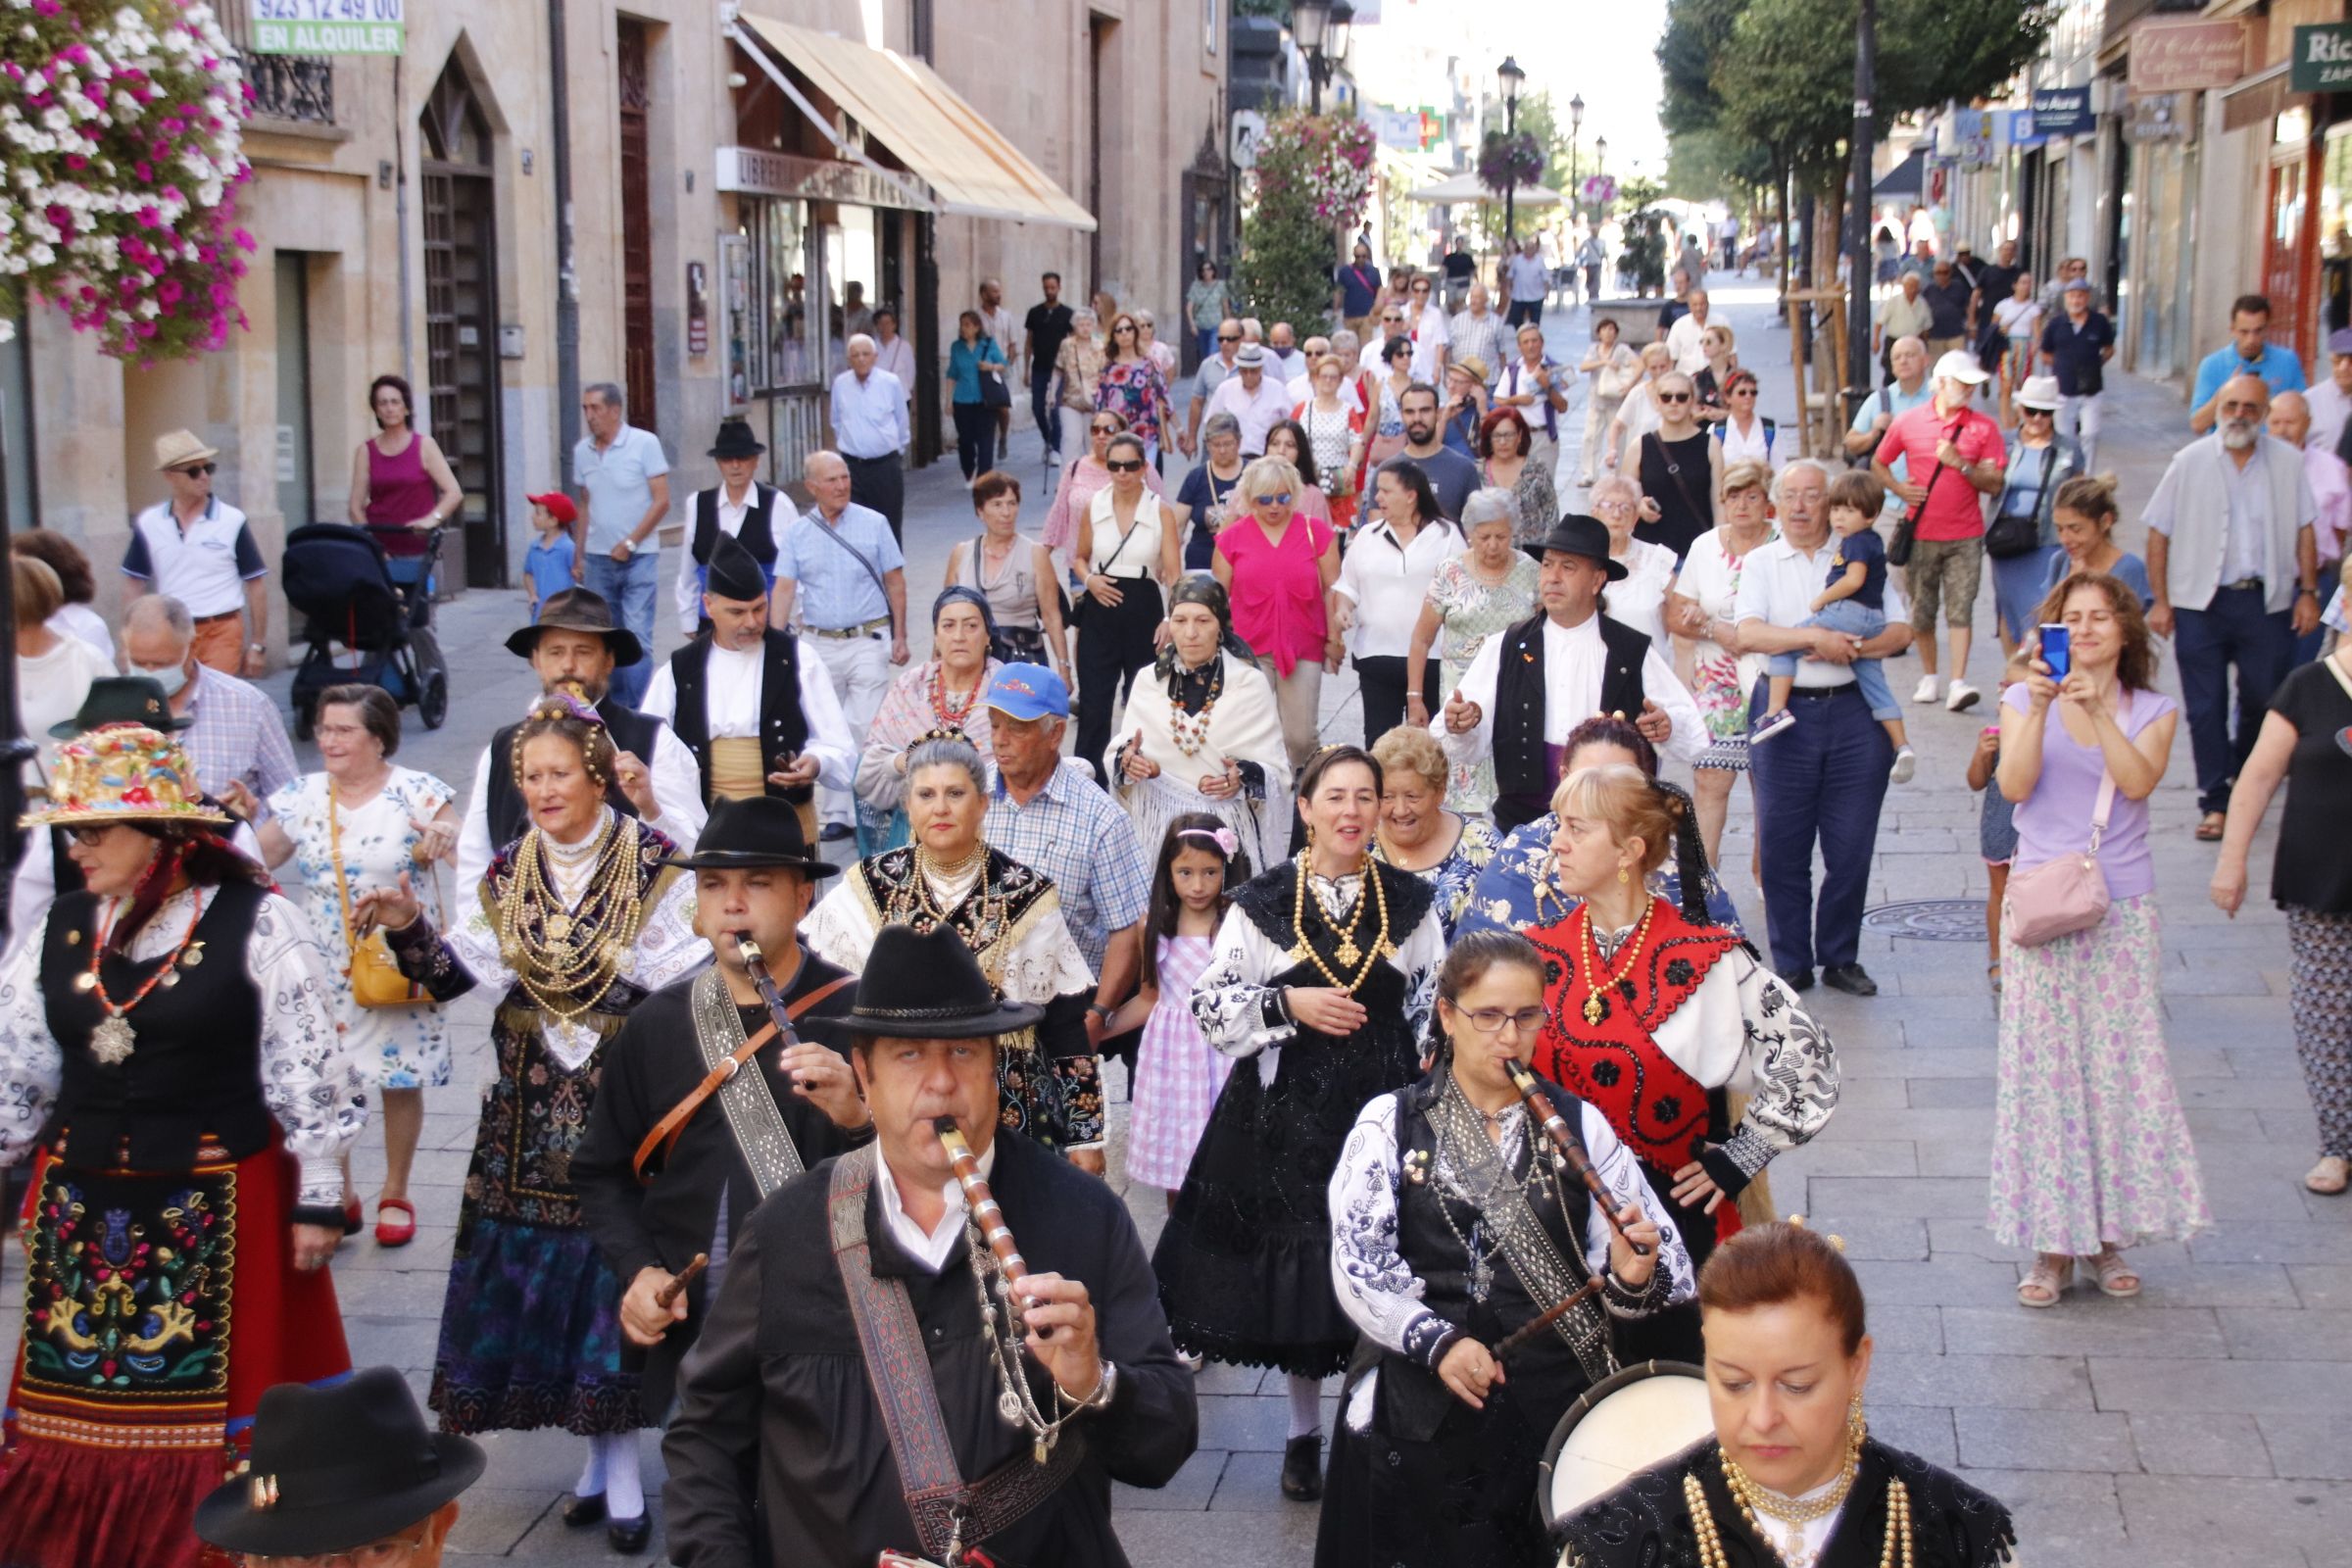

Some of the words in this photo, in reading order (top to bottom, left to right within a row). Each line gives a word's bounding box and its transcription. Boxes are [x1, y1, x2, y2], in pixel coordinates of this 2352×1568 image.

[261, 0, 299, 20] 923
[311, 0, 333, 20] 12
[340, 0, 366, 20] 49
[374, 0, 399, 20] 00
[259, 24, 289, 50] EN
[295, 24, 401, 52] ALQUILER
